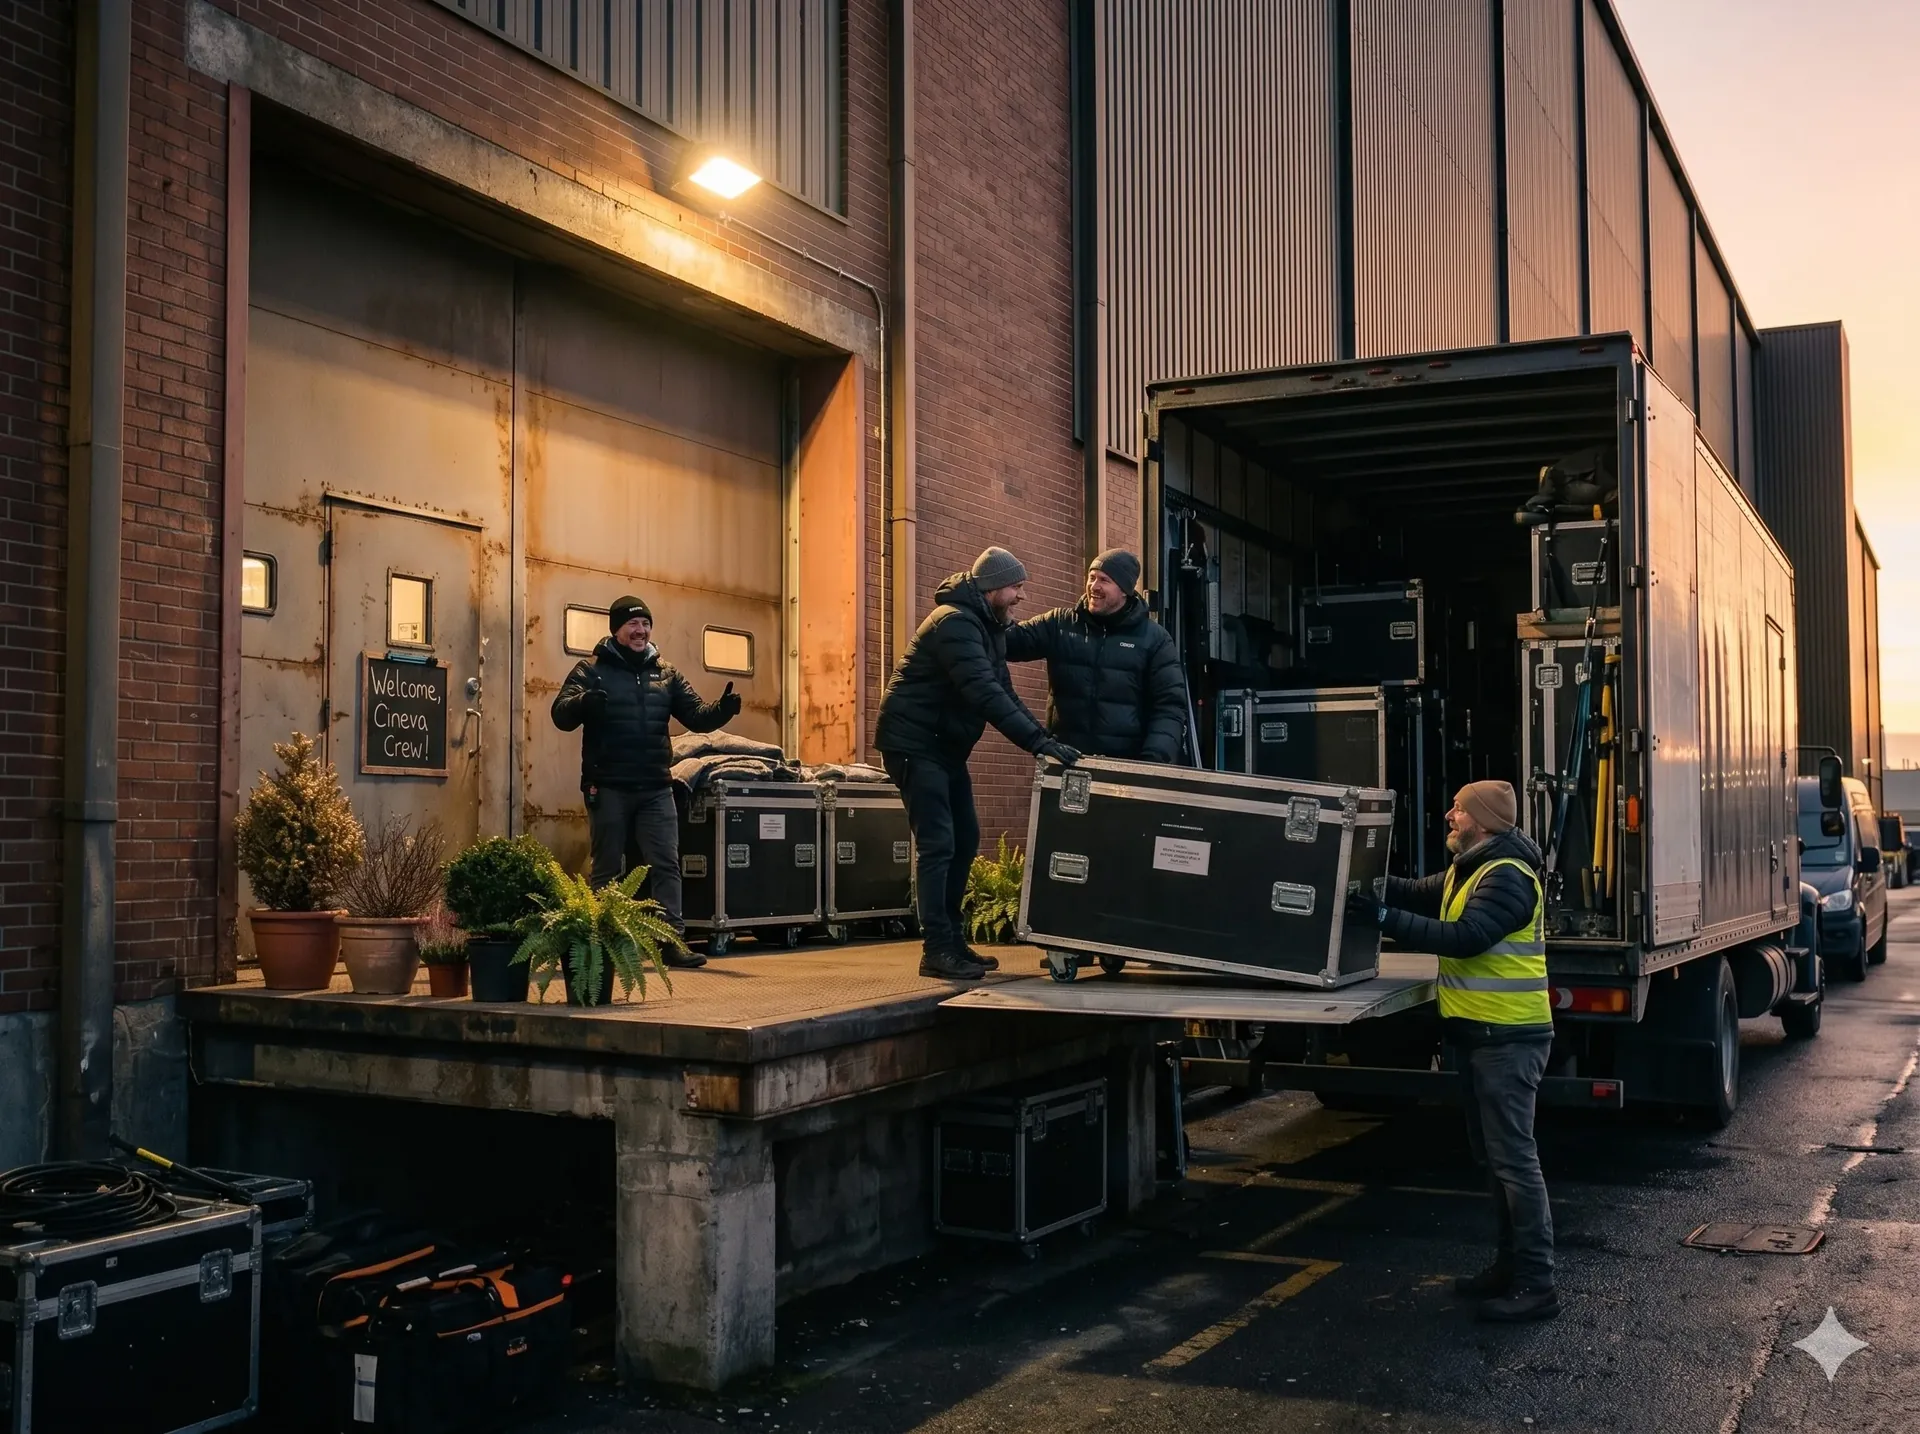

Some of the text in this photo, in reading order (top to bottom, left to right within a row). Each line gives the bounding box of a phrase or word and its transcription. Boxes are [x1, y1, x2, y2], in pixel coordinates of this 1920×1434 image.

[371, 666, 441, 704] Welcome,
[374, 702, 429, 731] Cineva
[384, 734, 429, 761] Crew!
